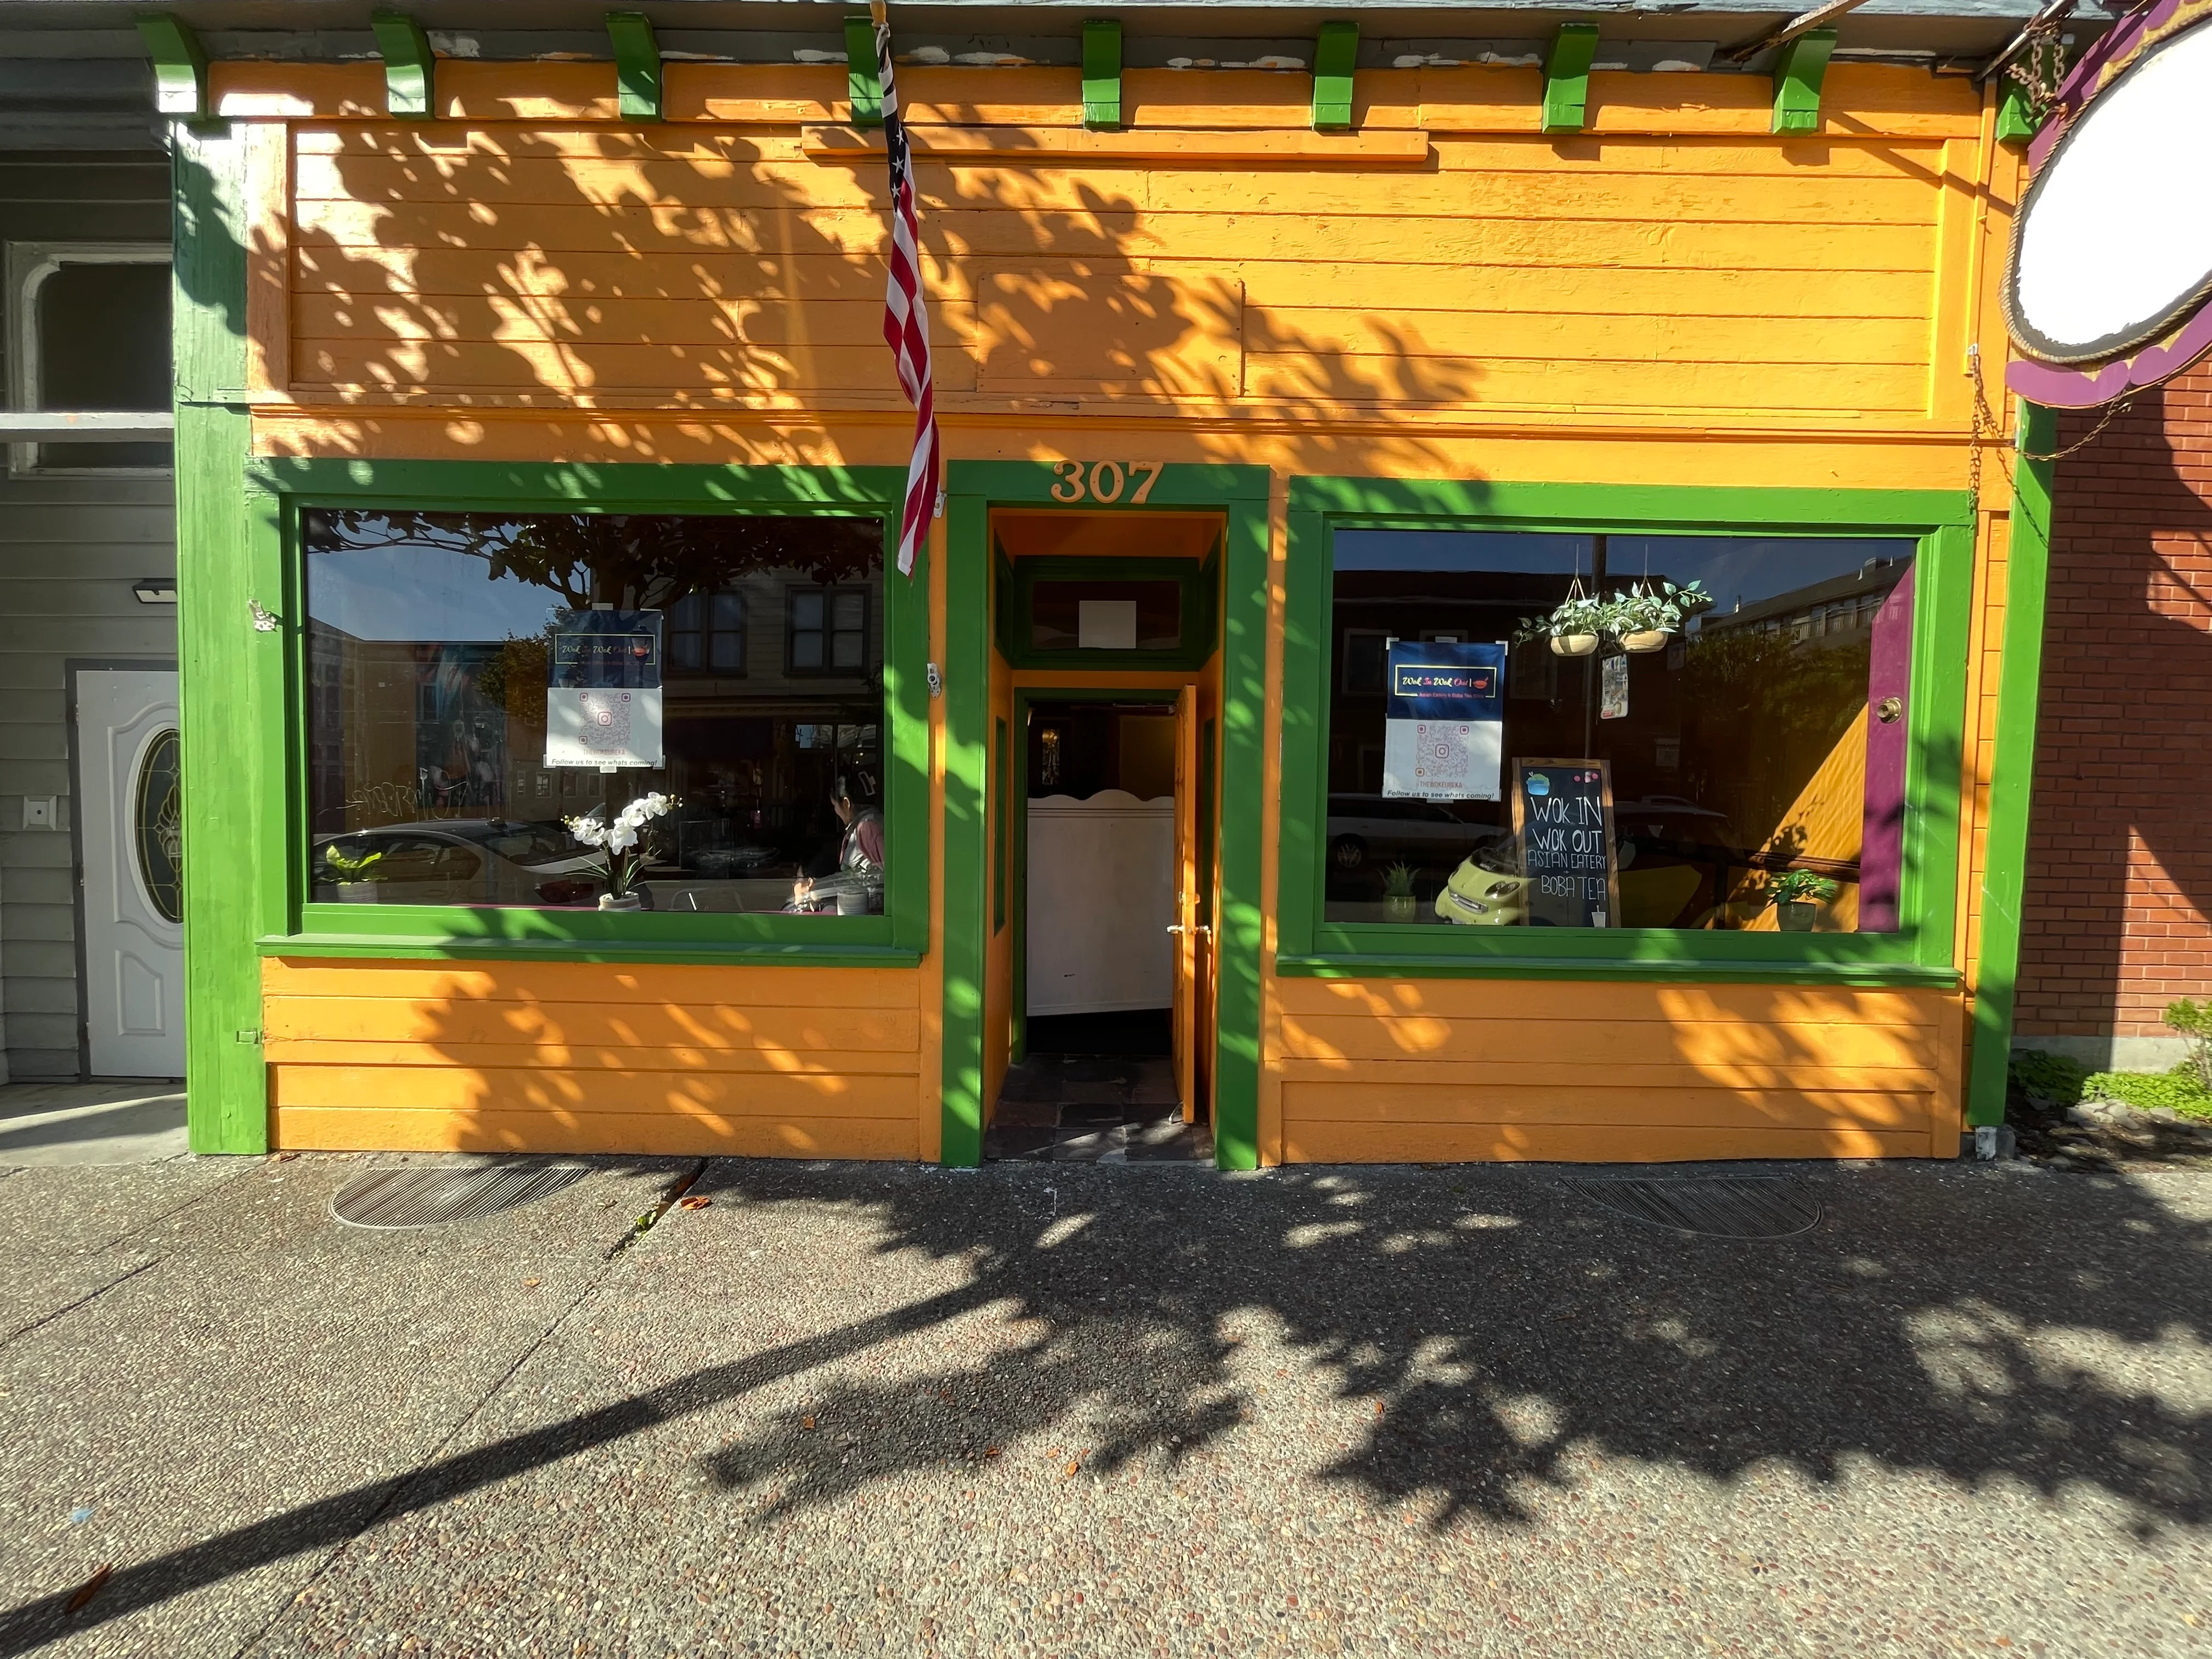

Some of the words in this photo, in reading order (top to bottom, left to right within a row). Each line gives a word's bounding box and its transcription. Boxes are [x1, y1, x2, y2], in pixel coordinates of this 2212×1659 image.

[1051, 460, 1164, 504] 307
[562, 645, 581, 654] Wok
[593, 645, 612, 654] Wok
[1402, 676, 1422, 686] Wok
[1423, 677, 1432, 685] In
[1434, 676, 1453, 687] Wok
[1454, 678, 1468, 686] Out
[1530, 797, 1571, 823] WOK
[1576, 796, 1602, 826] IN
[1532, 828, 1567, 851] WOK
[1572, 829, 1602, 854] OUT
[1528, 849, 1568, 869] ASIAN
[1571, 854, 1607, 870] EATERY
[1541, 874, 1575, 898] BOBA
[1577, 877, 1606, 901] TEA
